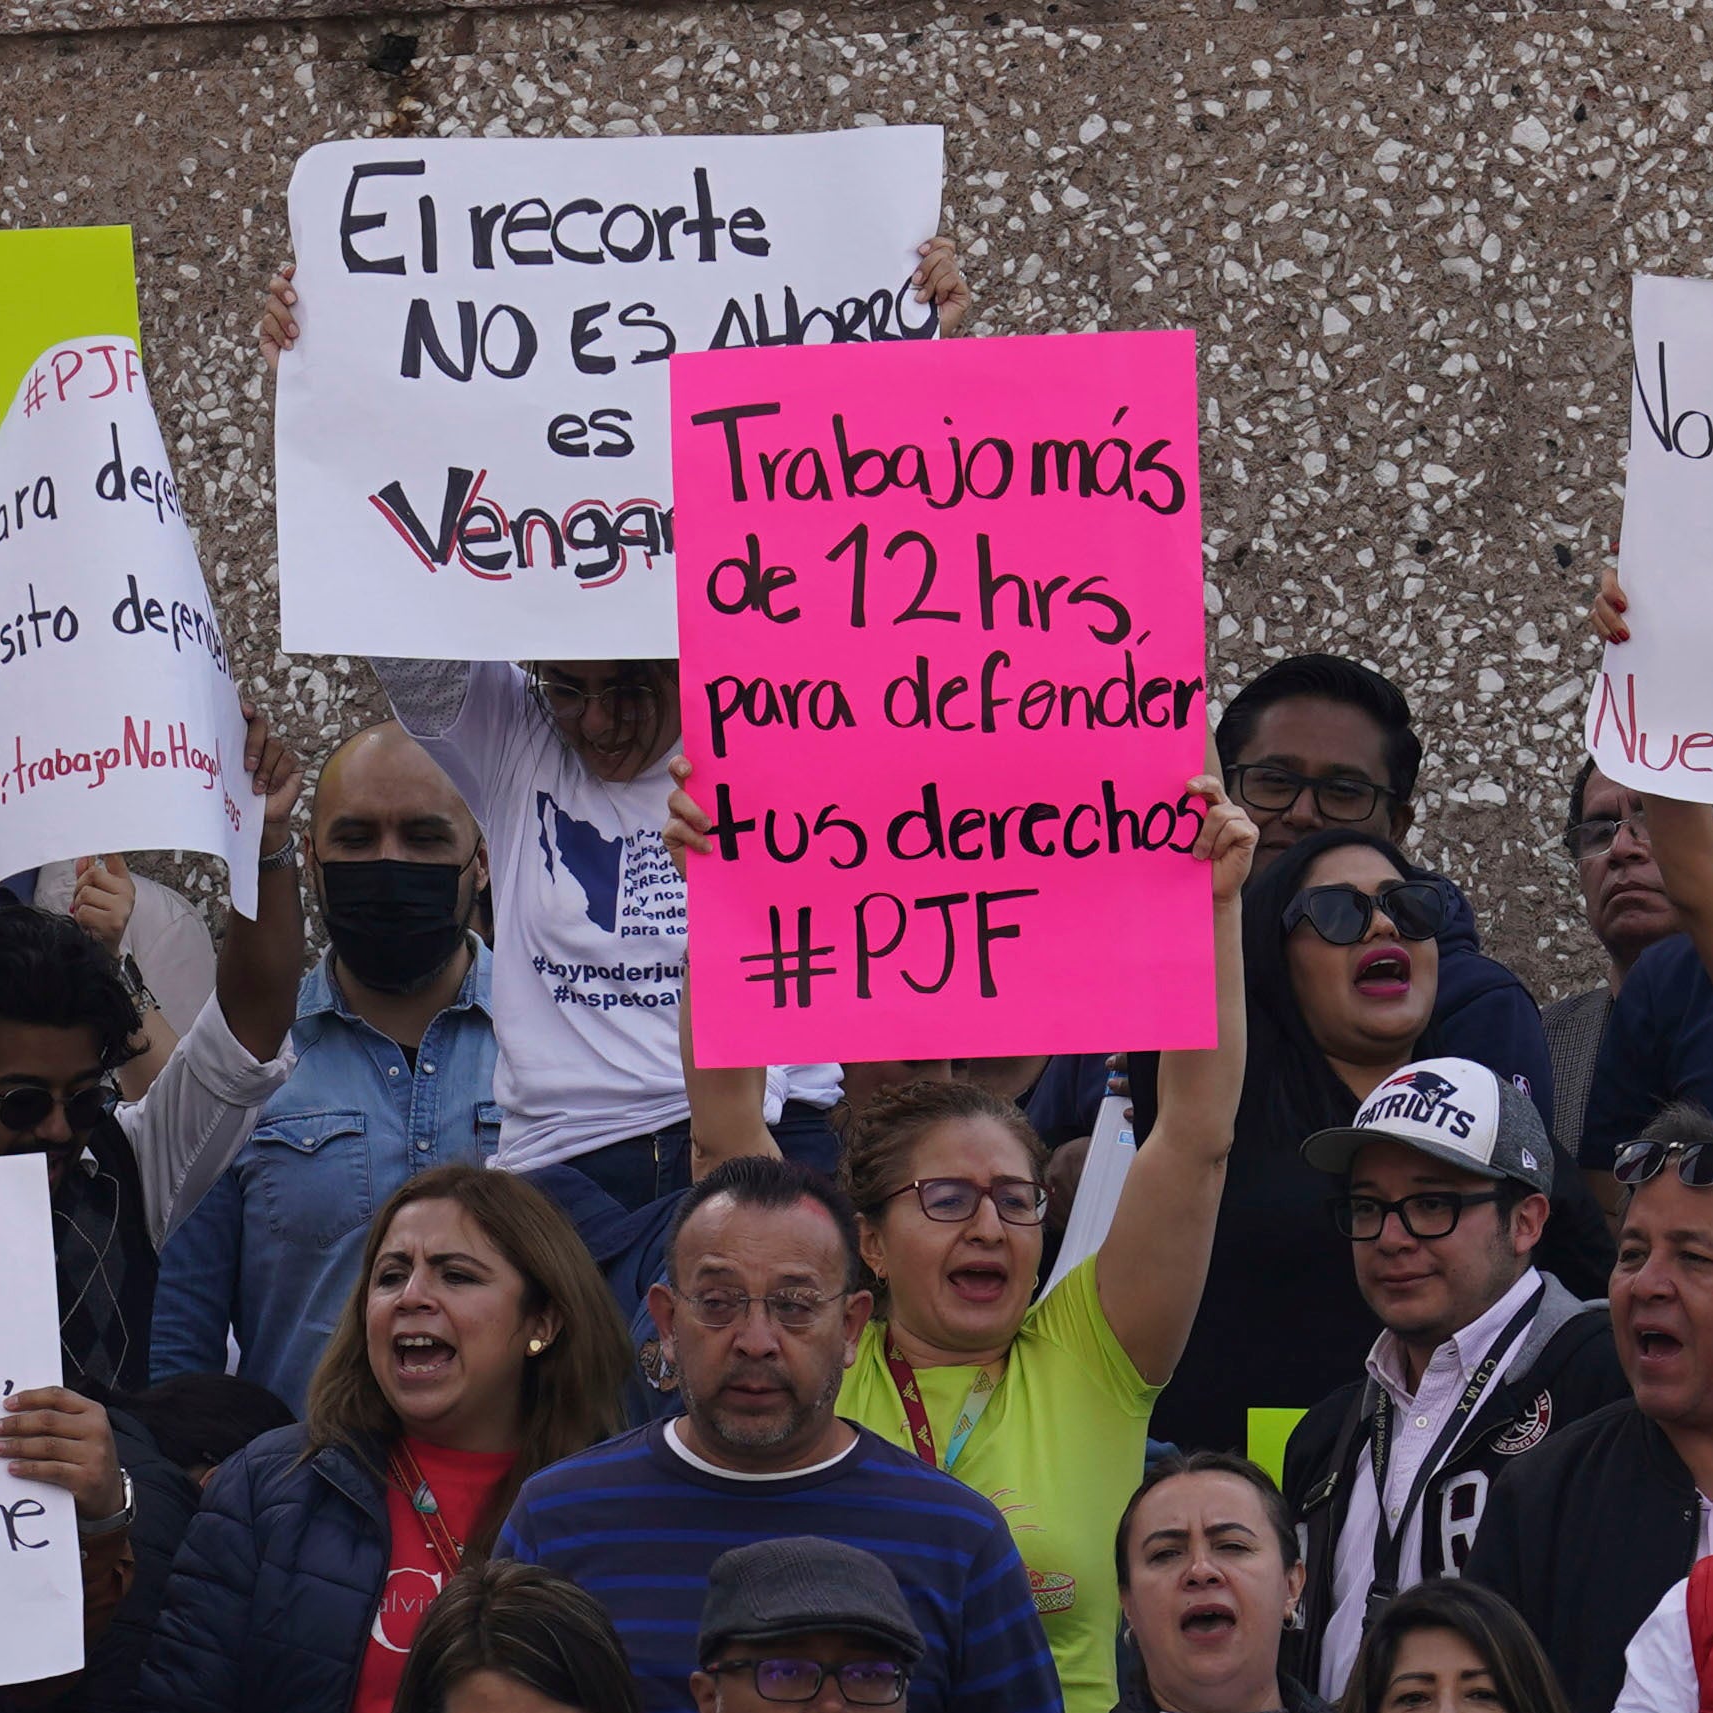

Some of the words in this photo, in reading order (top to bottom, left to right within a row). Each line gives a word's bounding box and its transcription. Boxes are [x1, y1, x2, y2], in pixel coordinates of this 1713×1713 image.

[470, 167, 771, 269] recorte
[401, 299, 538, 380] NO
[571, 301, 675, 375] ES
[546, 407, 634, 458] es
[690, 402, 1014, 509] Trabajo
[1030, 406, 1186, 514] más
[707, 559, 800, 624] de
[824, 523, 960, 625] 12
[705, 681, 857, 758] para
[706, 782, 867, 868] tus
[889, 782, 1202, 862] derechos
[620, 924, 660, 938] para
[739, 889, 1039, 1009] #PJF
[1459, 1358, 1497, 1414] CDMX
